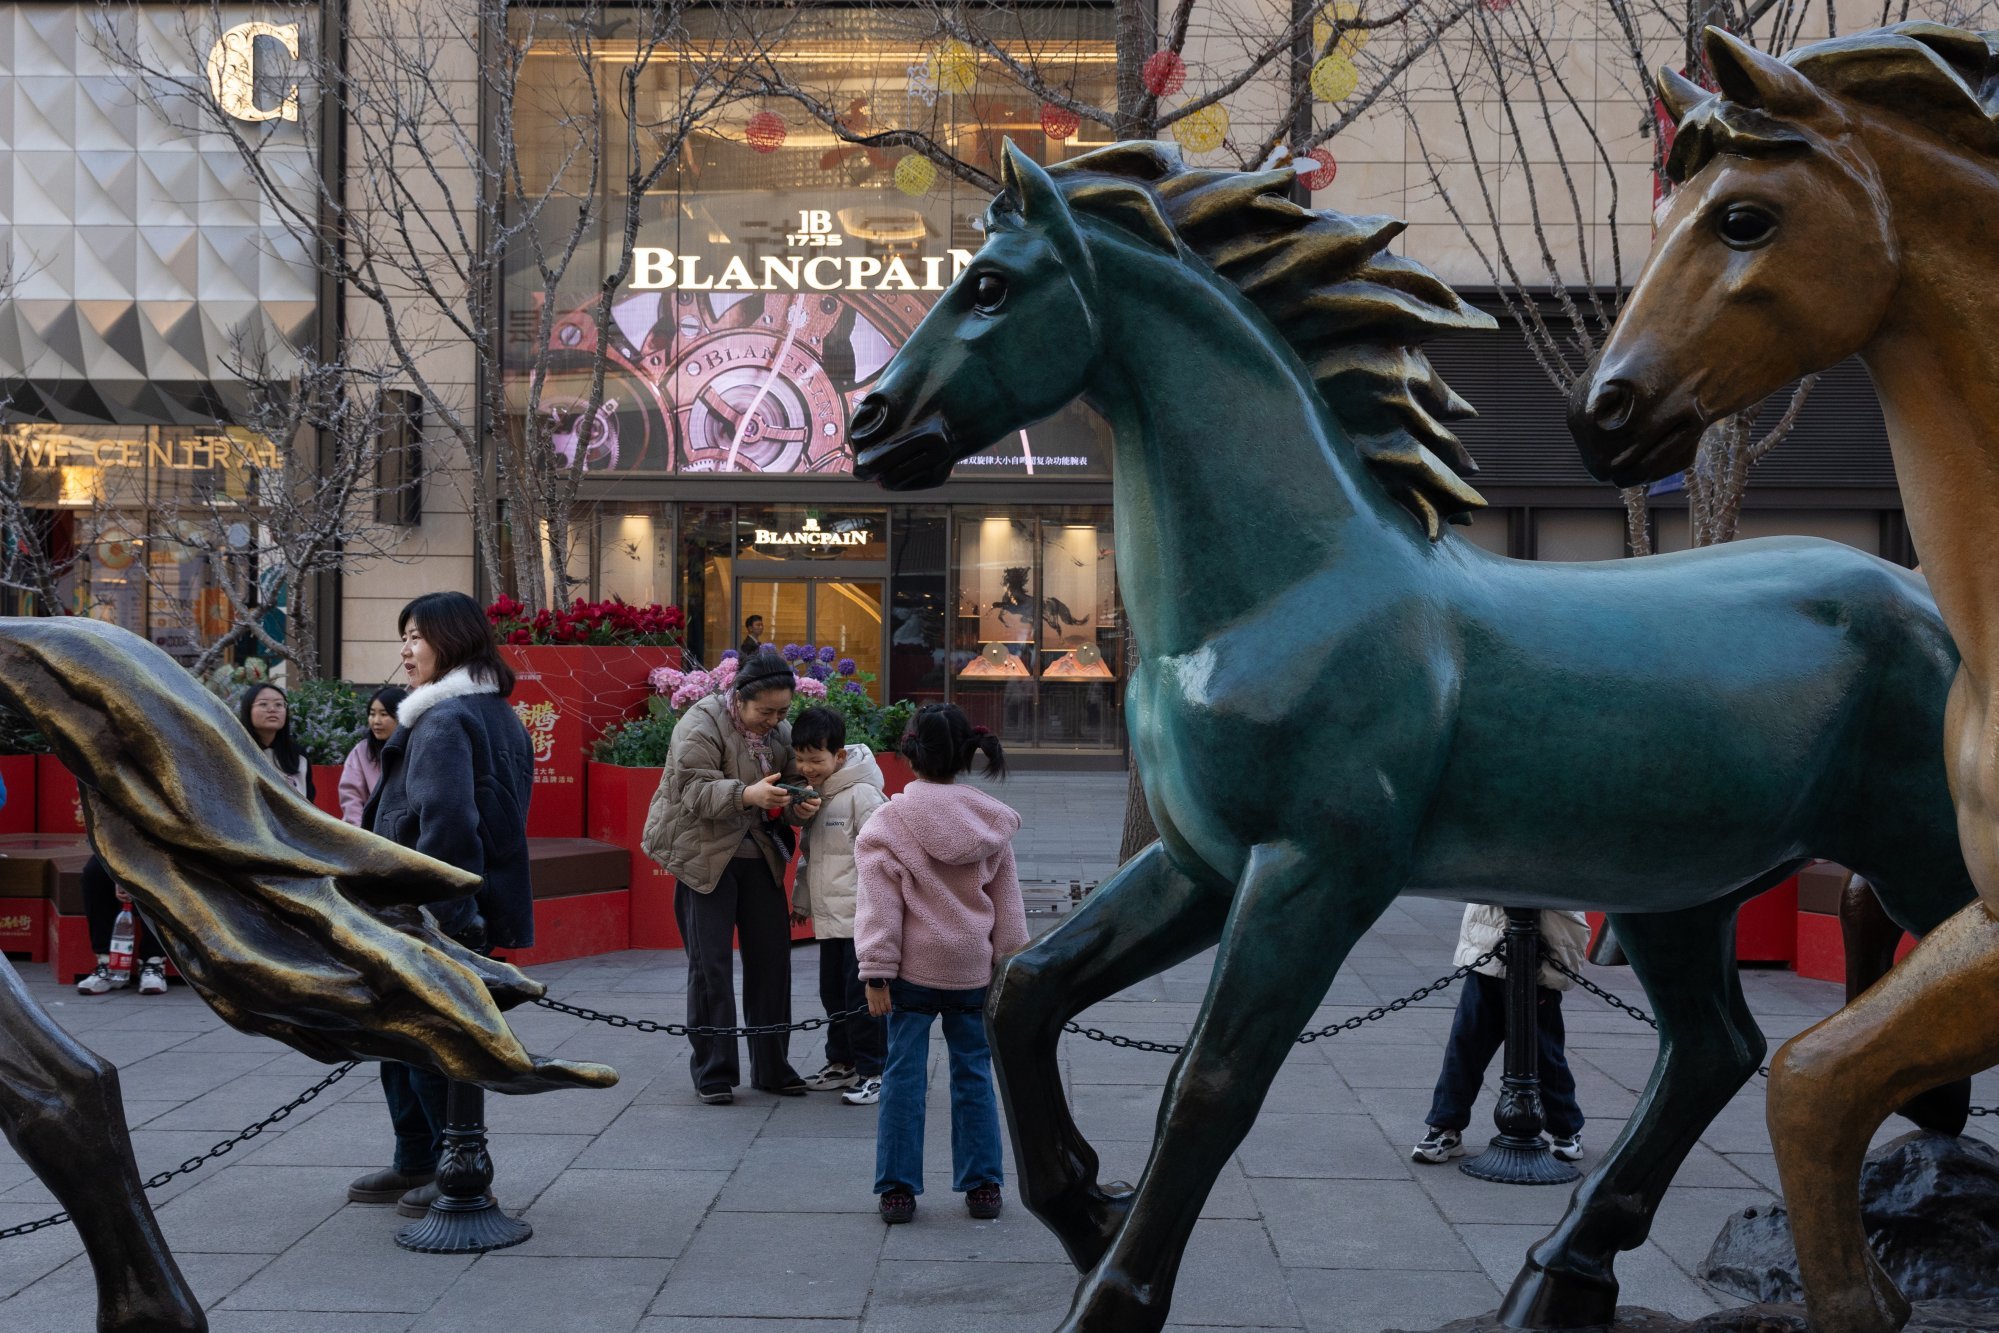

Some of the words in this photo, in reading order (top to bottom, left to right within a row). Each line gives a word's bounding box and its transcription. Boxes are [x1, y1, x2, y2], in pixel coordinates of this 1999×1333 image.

[207, 21, 300, 122] C
[787, 235, 842, 246] 1735
[4, 439, 72, 468] WF
[92, 439, 284, 469] CENTRAL
[755, 530, 868, 545] BLANCPAIN
